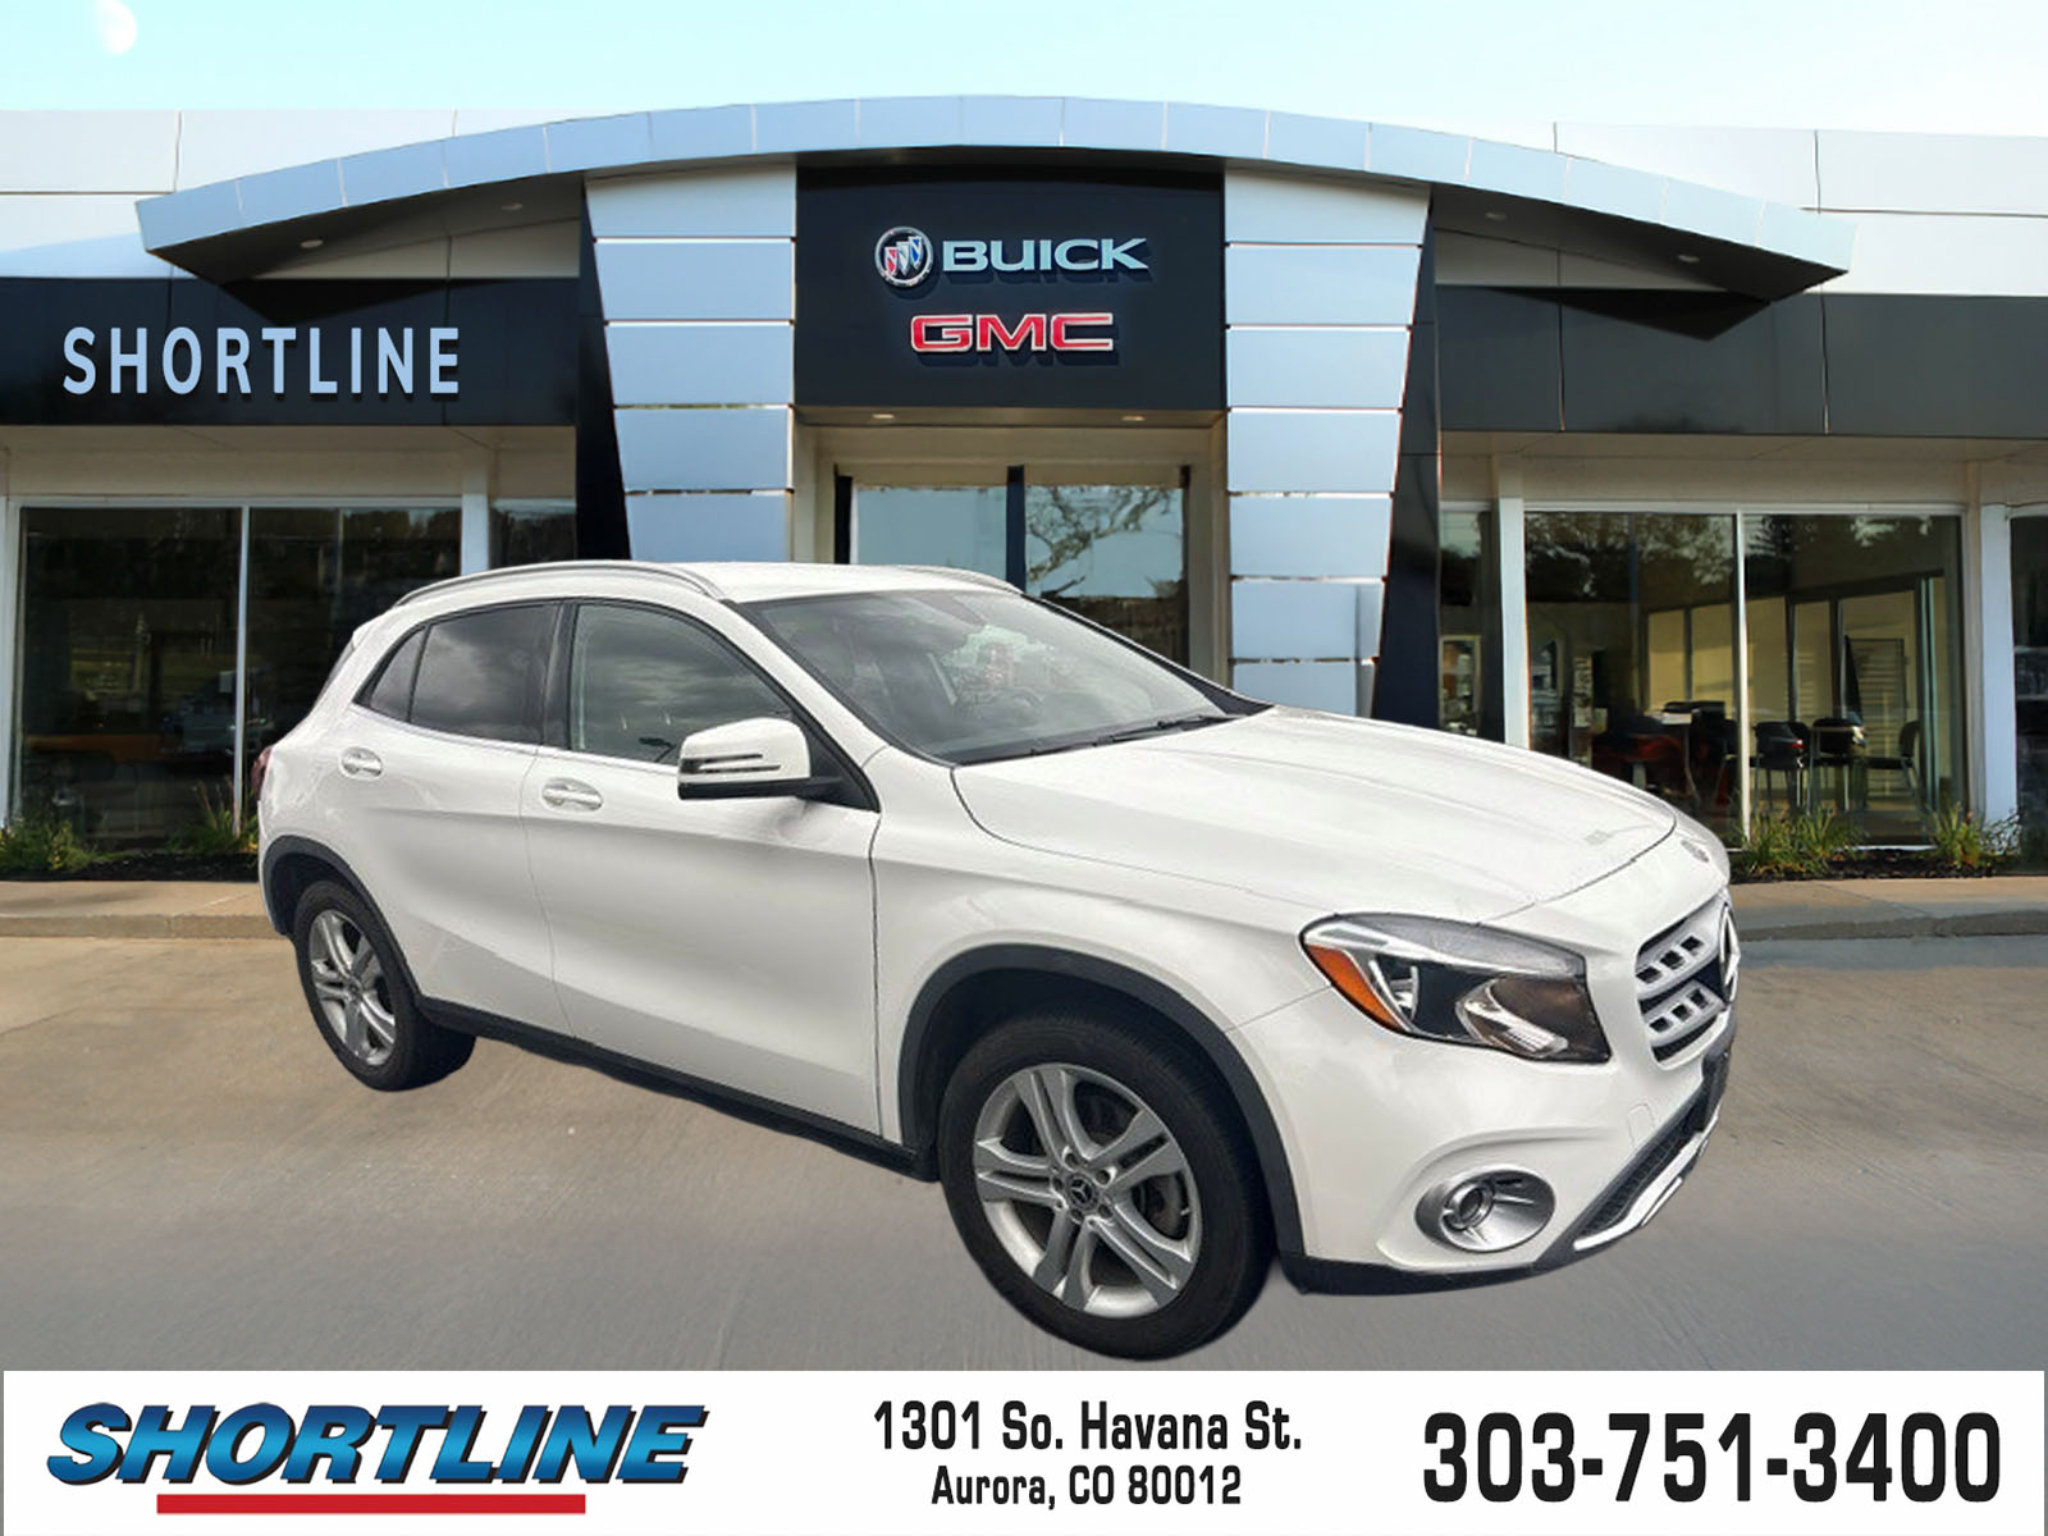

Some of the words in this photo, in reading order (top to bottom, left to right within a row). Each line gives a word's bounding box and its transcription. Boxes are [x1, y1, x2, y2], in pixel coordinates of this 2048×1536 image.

[942, 239, 1149, 272] BUICK
[910, 312, 1114, 353] GMC
[63, 326, 459, 394] SHORTLINE
